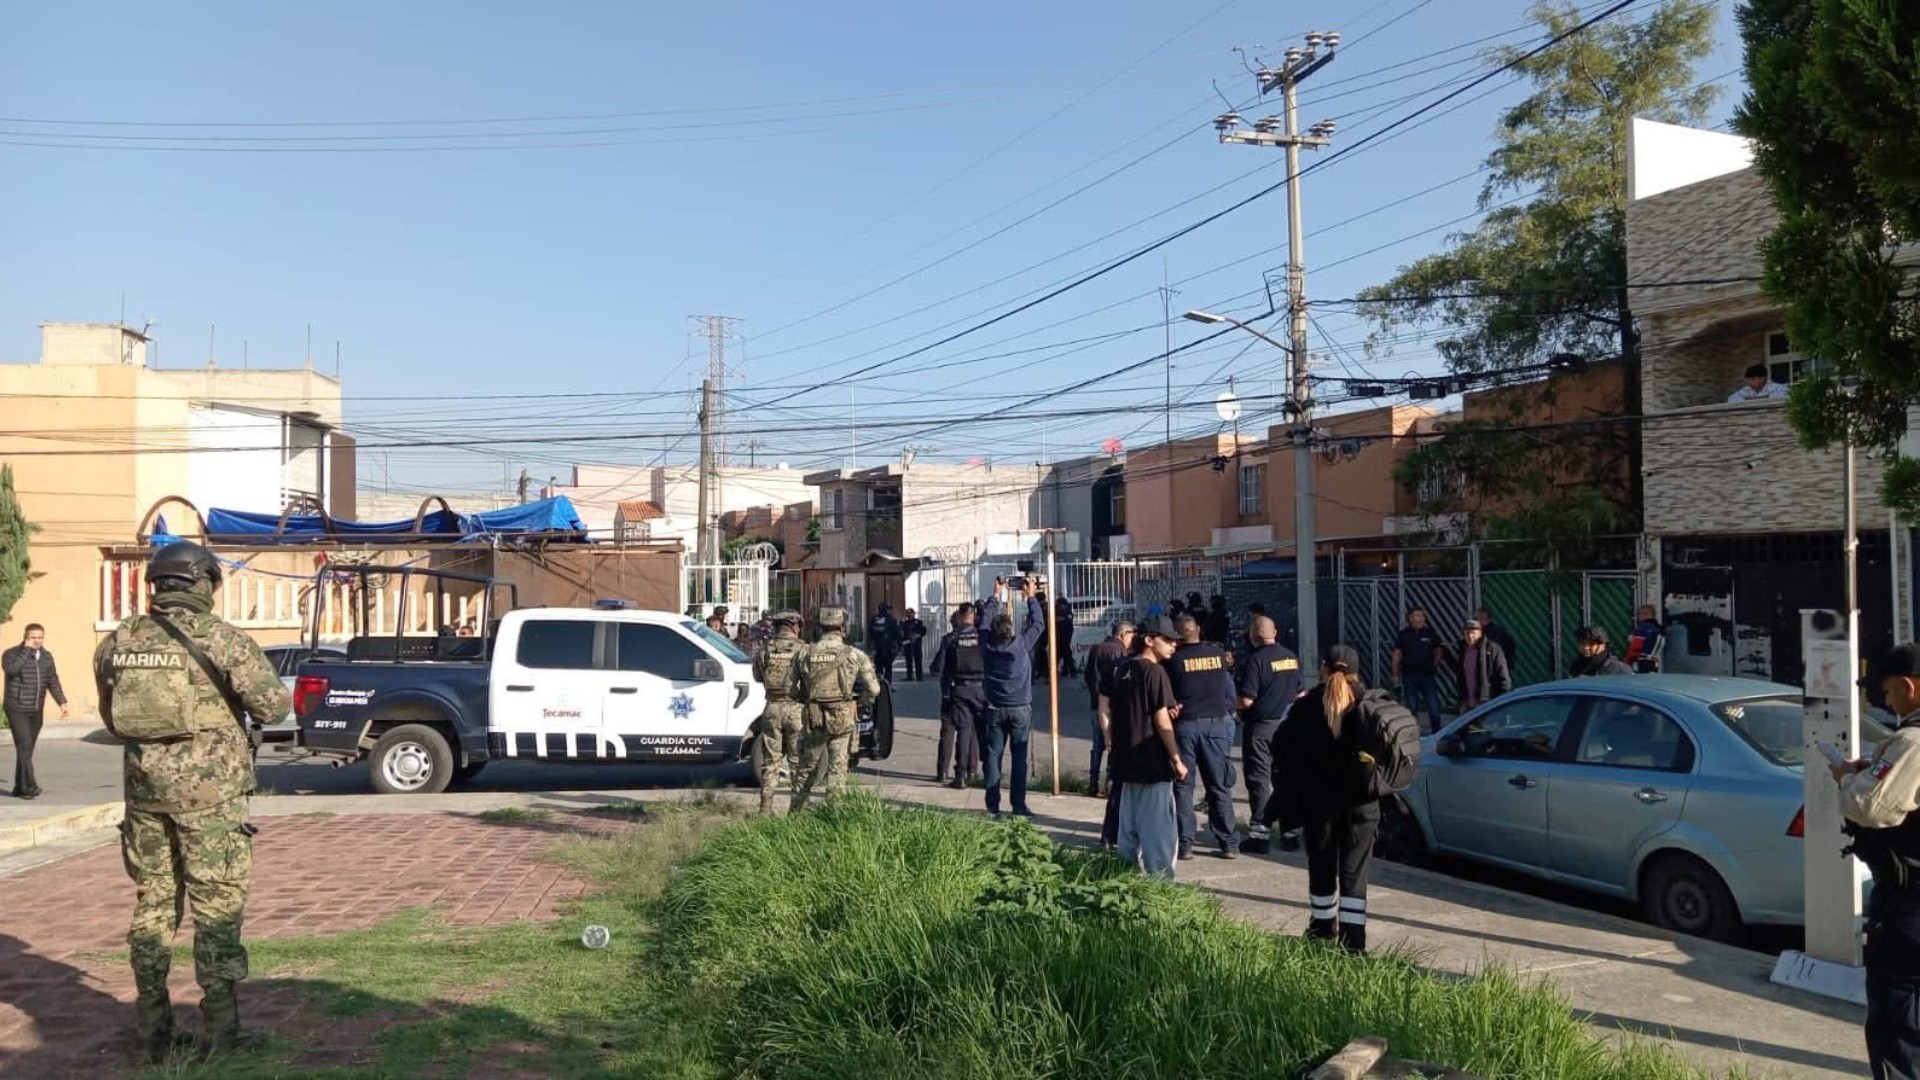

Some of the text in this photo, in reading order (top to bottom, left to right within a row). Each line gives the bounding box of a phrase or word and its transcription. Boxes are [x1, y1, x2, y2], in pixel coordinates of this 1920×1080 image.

[113, 653, 182, 667] MARINA
[640, 736, 713, 745] GUARDIA CIVIL
[654, 745, 702, 755] TECÁMAC
